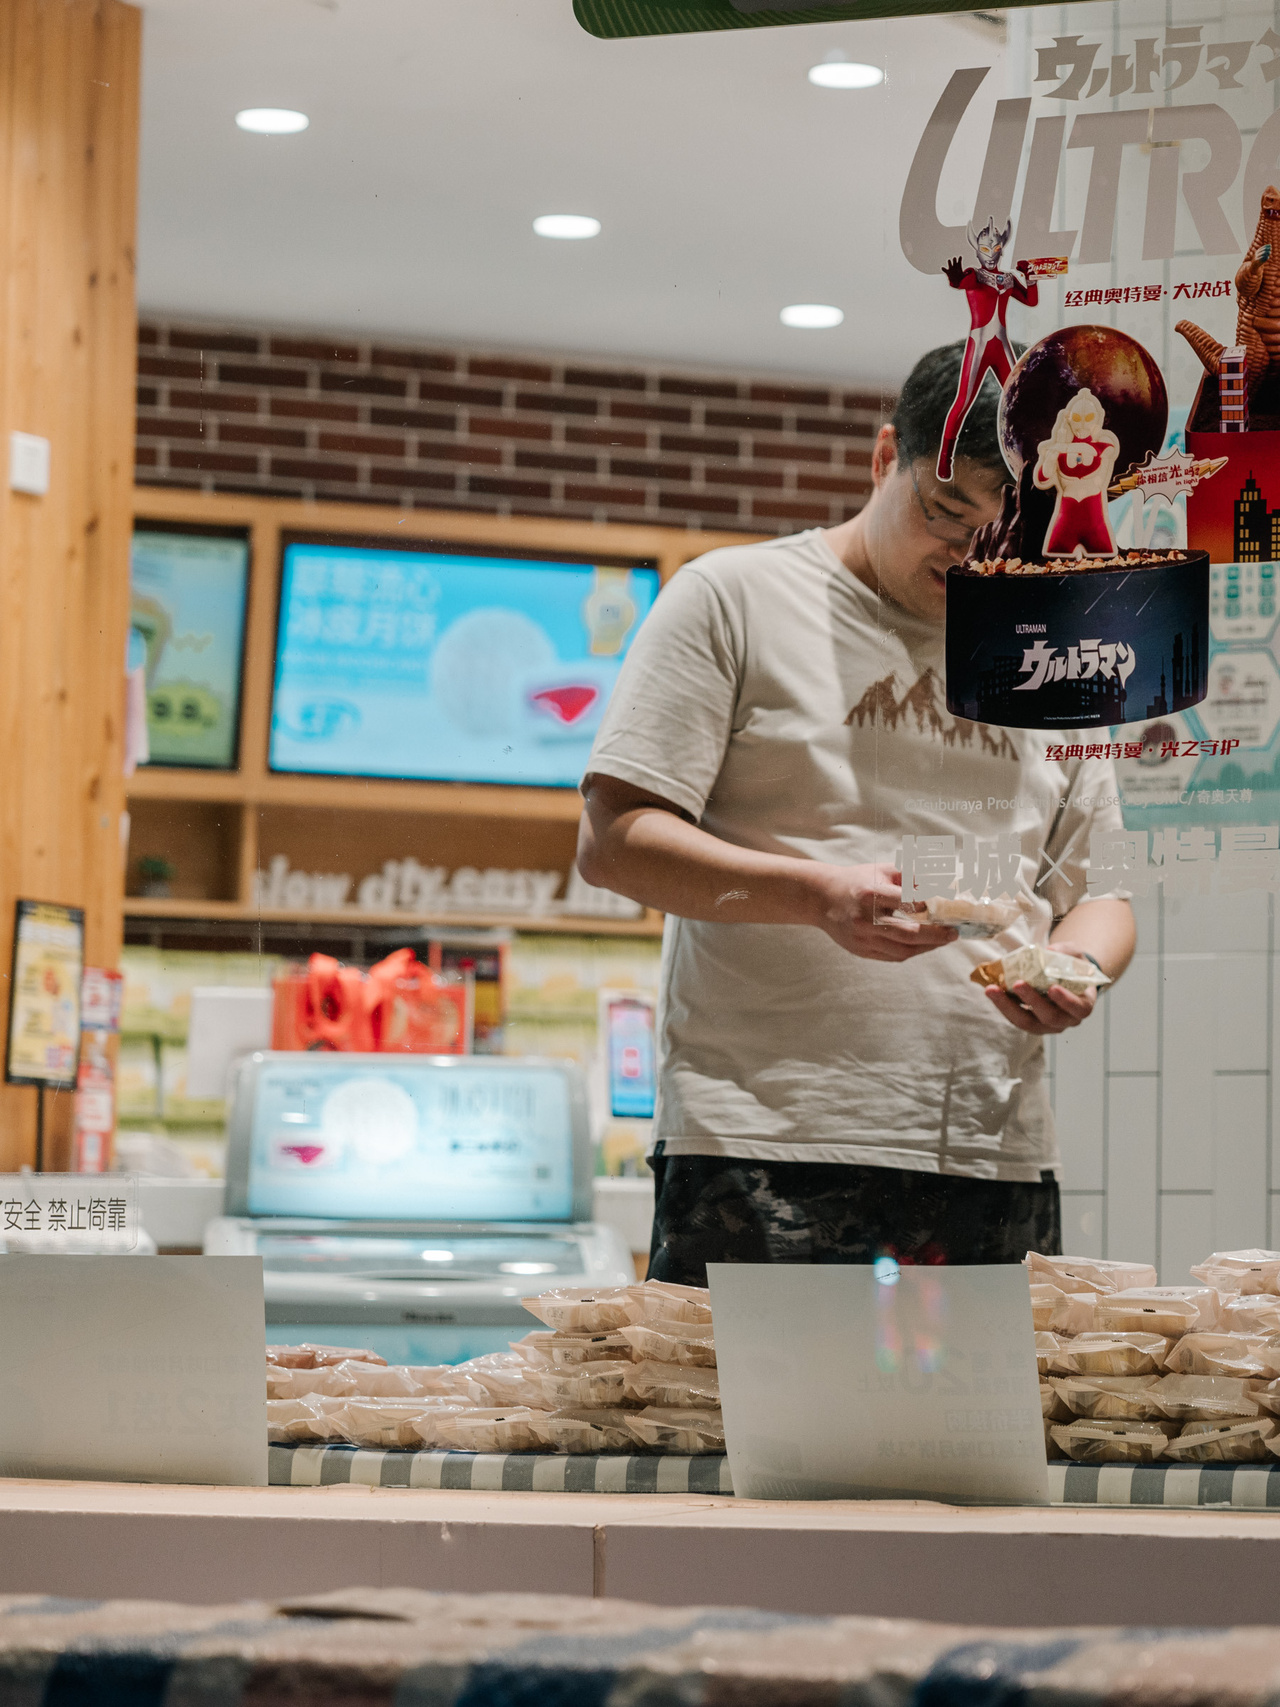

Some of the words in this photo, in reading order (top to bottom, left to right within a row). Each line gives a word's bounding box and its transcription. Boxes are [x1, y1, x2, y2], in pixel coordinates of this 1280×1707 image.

[1064, 280, 1232, 308] 经典奥特曼·大决战
[1015, 623, 1047, 634] ULTRAMAN
[1012, 638, 1136, 690] ウルトラマン
[1045, 738, 1240, 763] 经典奥特曼·光之守护
[0, 1198, 42, 1230] 安全
[48, 1196, 127, 1231] 禁止倚靠
